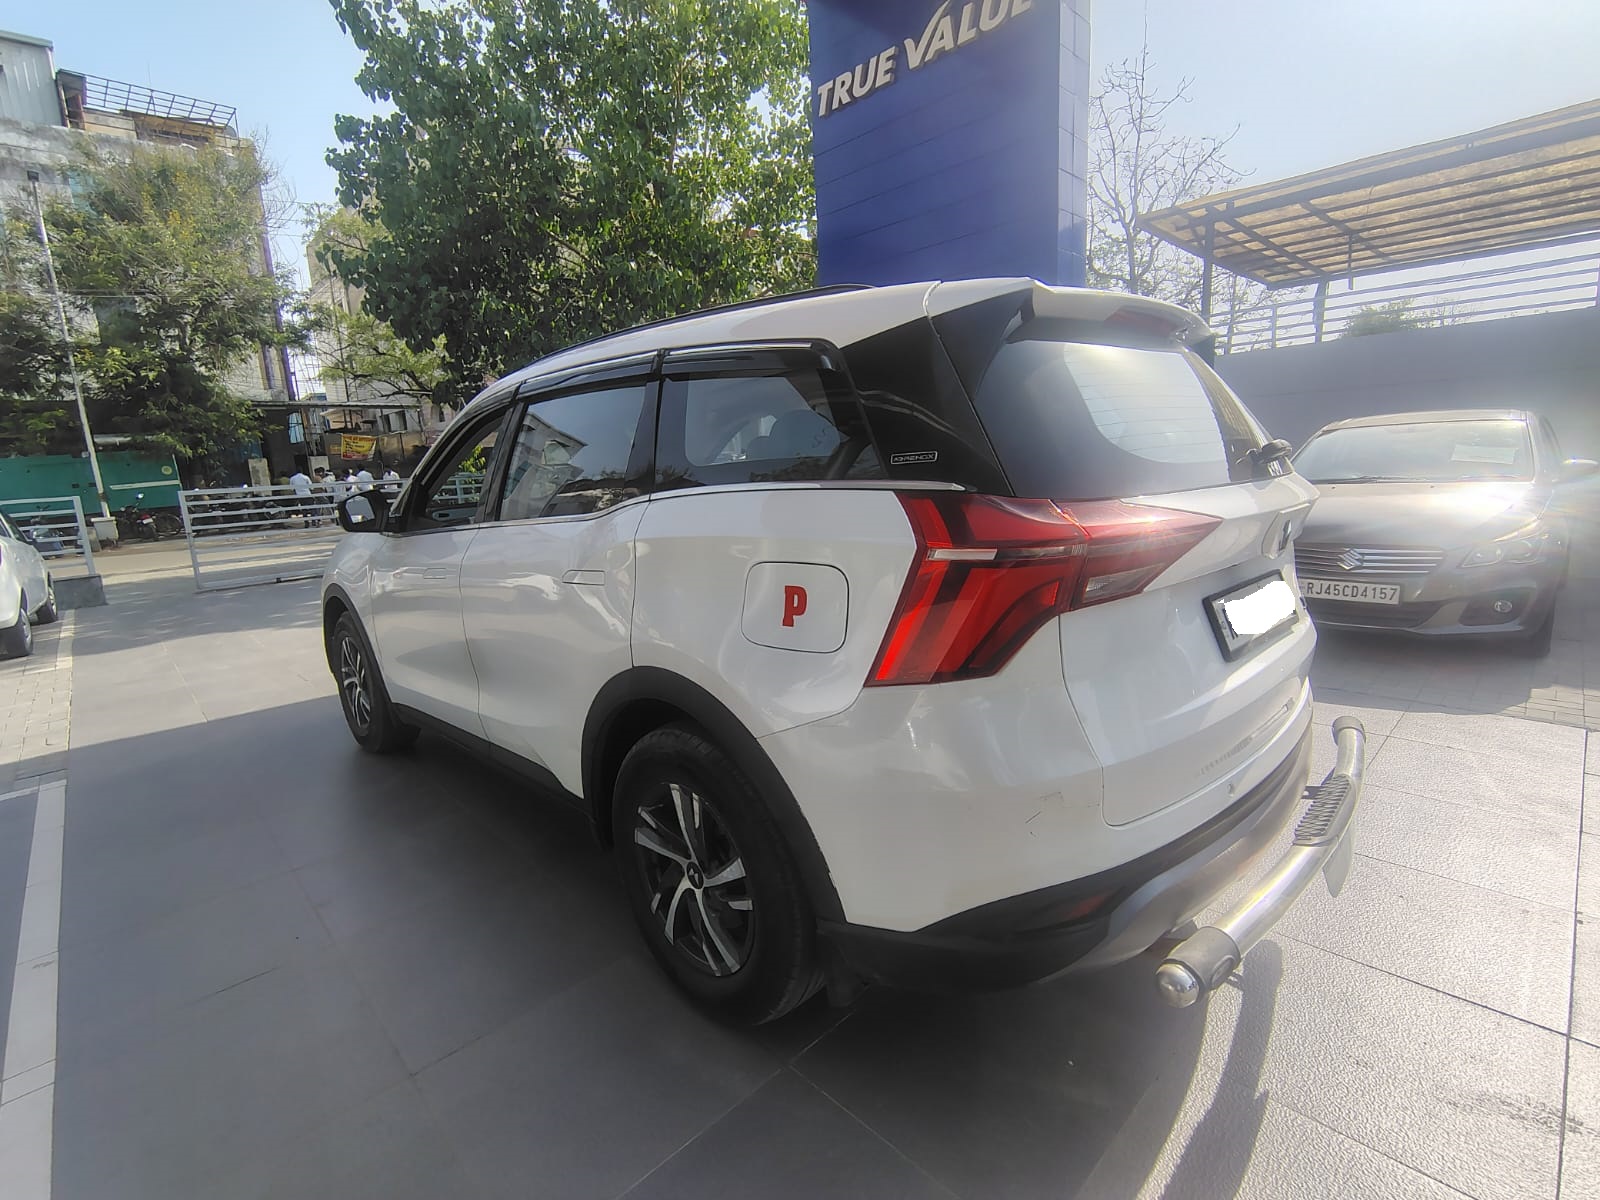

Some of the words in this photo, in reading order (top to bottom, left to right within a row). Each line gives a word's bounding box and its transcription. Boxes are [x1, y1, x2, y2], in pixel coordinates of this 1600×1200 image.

[817, 45, 896, 117] TRUE
[782, 585, 807, 627] P
[1306, 582, 1398, 601] RJ45CD4157
